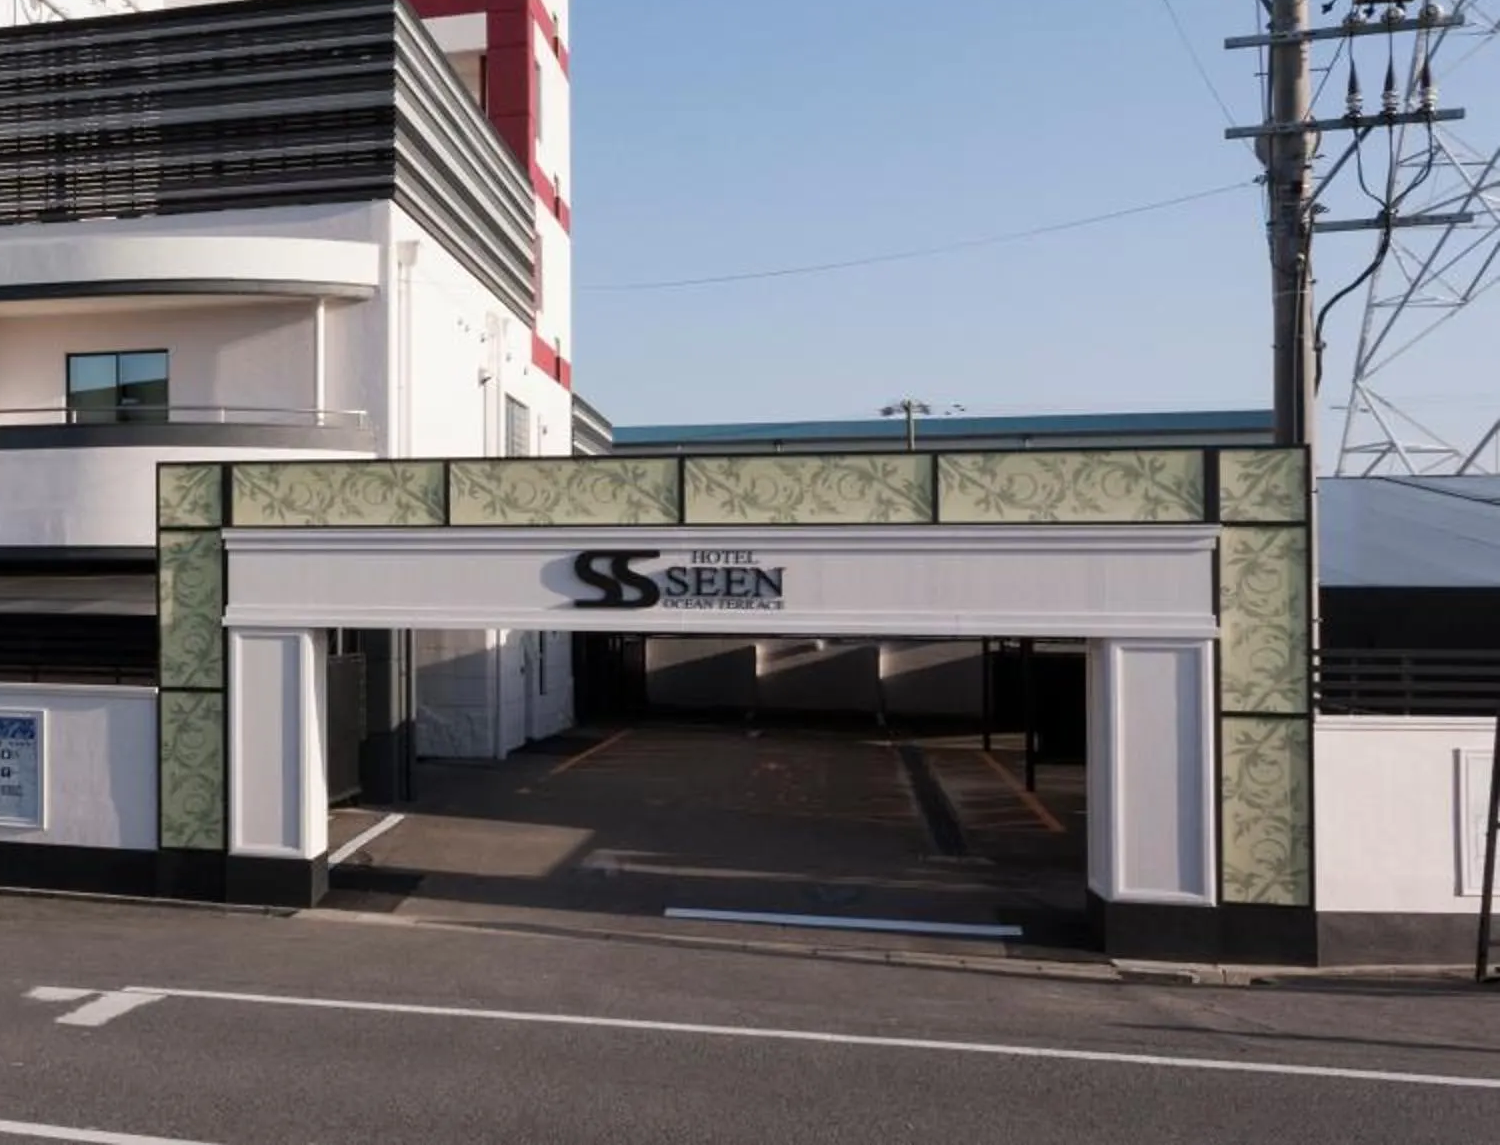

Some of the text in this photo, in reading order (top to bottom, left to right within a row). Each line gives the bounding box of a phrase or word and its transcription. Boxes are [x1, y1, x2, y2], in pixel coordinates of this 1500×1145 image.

[691, 550, 758, 564] HOTEL
[665, 566, 786, 597] SEEN
[662, 598, 784, 611] OCEAN TERRACE
